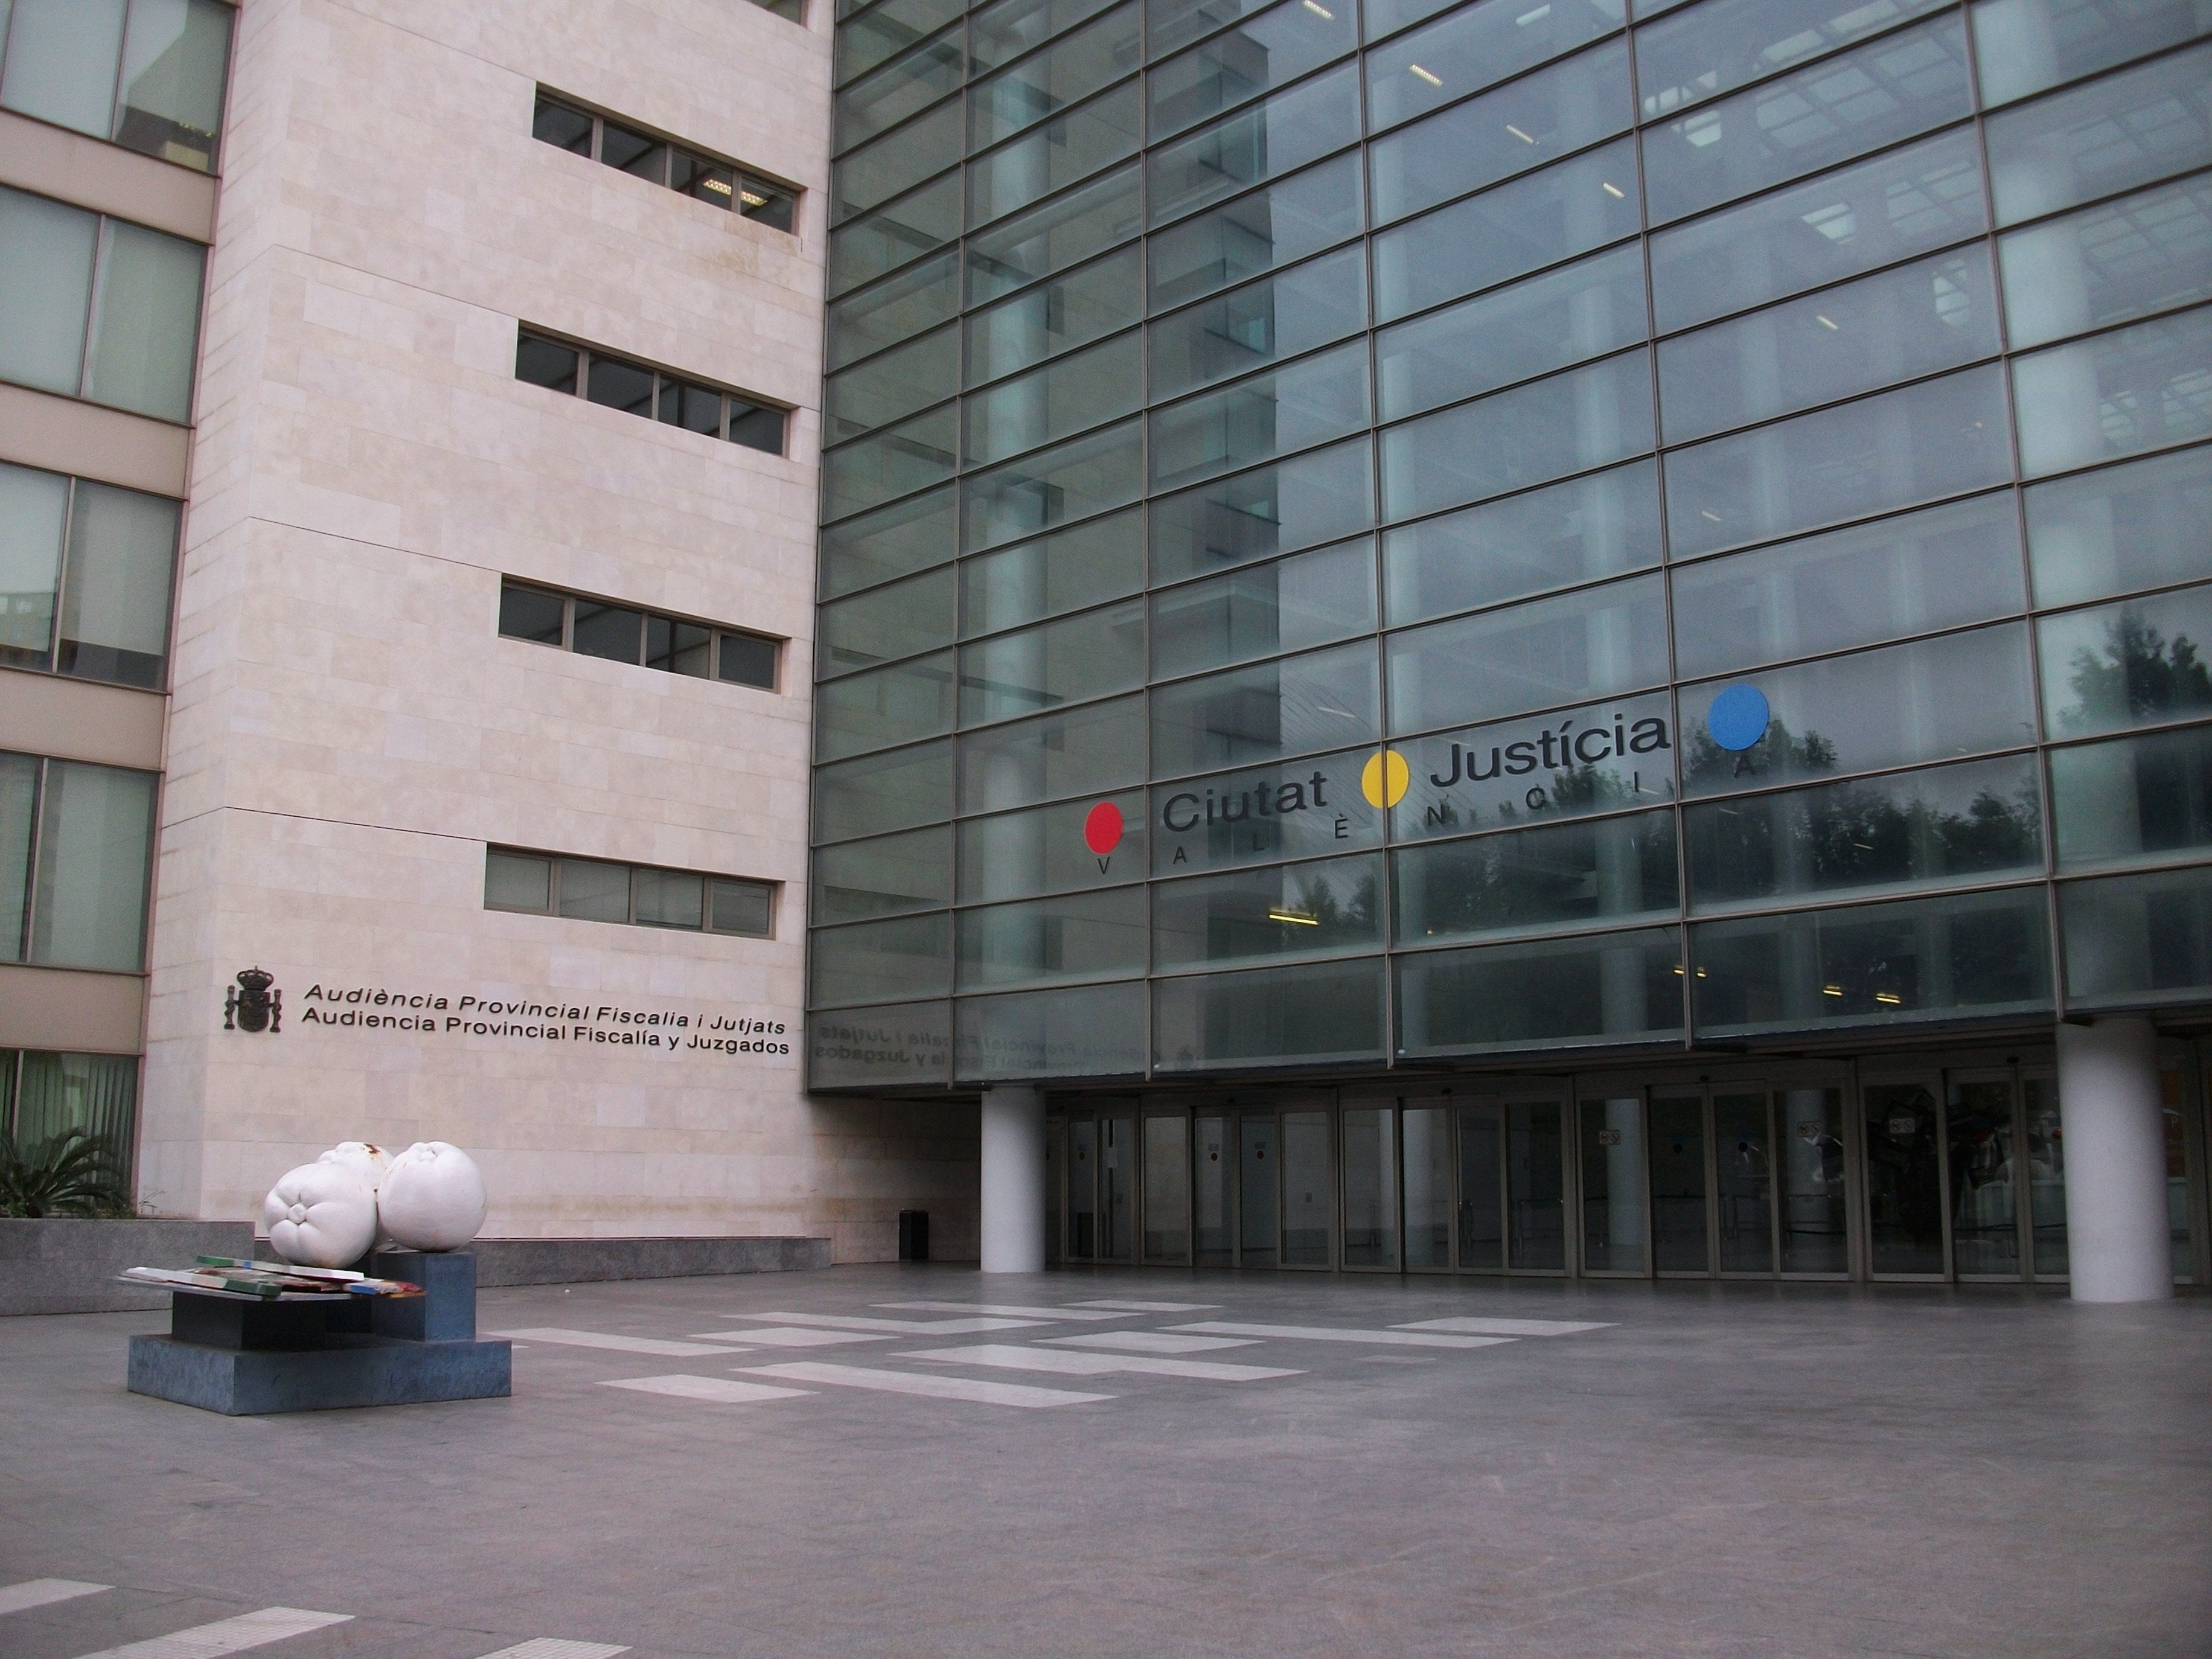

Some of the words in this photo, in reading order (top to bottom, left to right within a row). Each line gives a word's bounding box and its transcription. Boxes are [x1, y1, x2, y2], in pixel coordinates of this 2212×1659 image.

[1163, 771, 1327, 832] Ciutat
[1430, 713, 1671, 788] Justícia
[302, 1006, 436, 1032] Audiencia
[446, 1017, 566, 1040] Provincial
[574, 1026, 660, 1046] Fiscalía
[668, 1035, 680, 1050] y
[687, 1034, 789, 1054] Juzgados
[304, 983, 448, 1010] Audiència
[459, 996, 589, 1020] Provincial
[596, 1006, 688, 1027] Fiscalia
[697, 1014, 703, 1028] i
[710, 1015, 785, 1035] Jutjats
